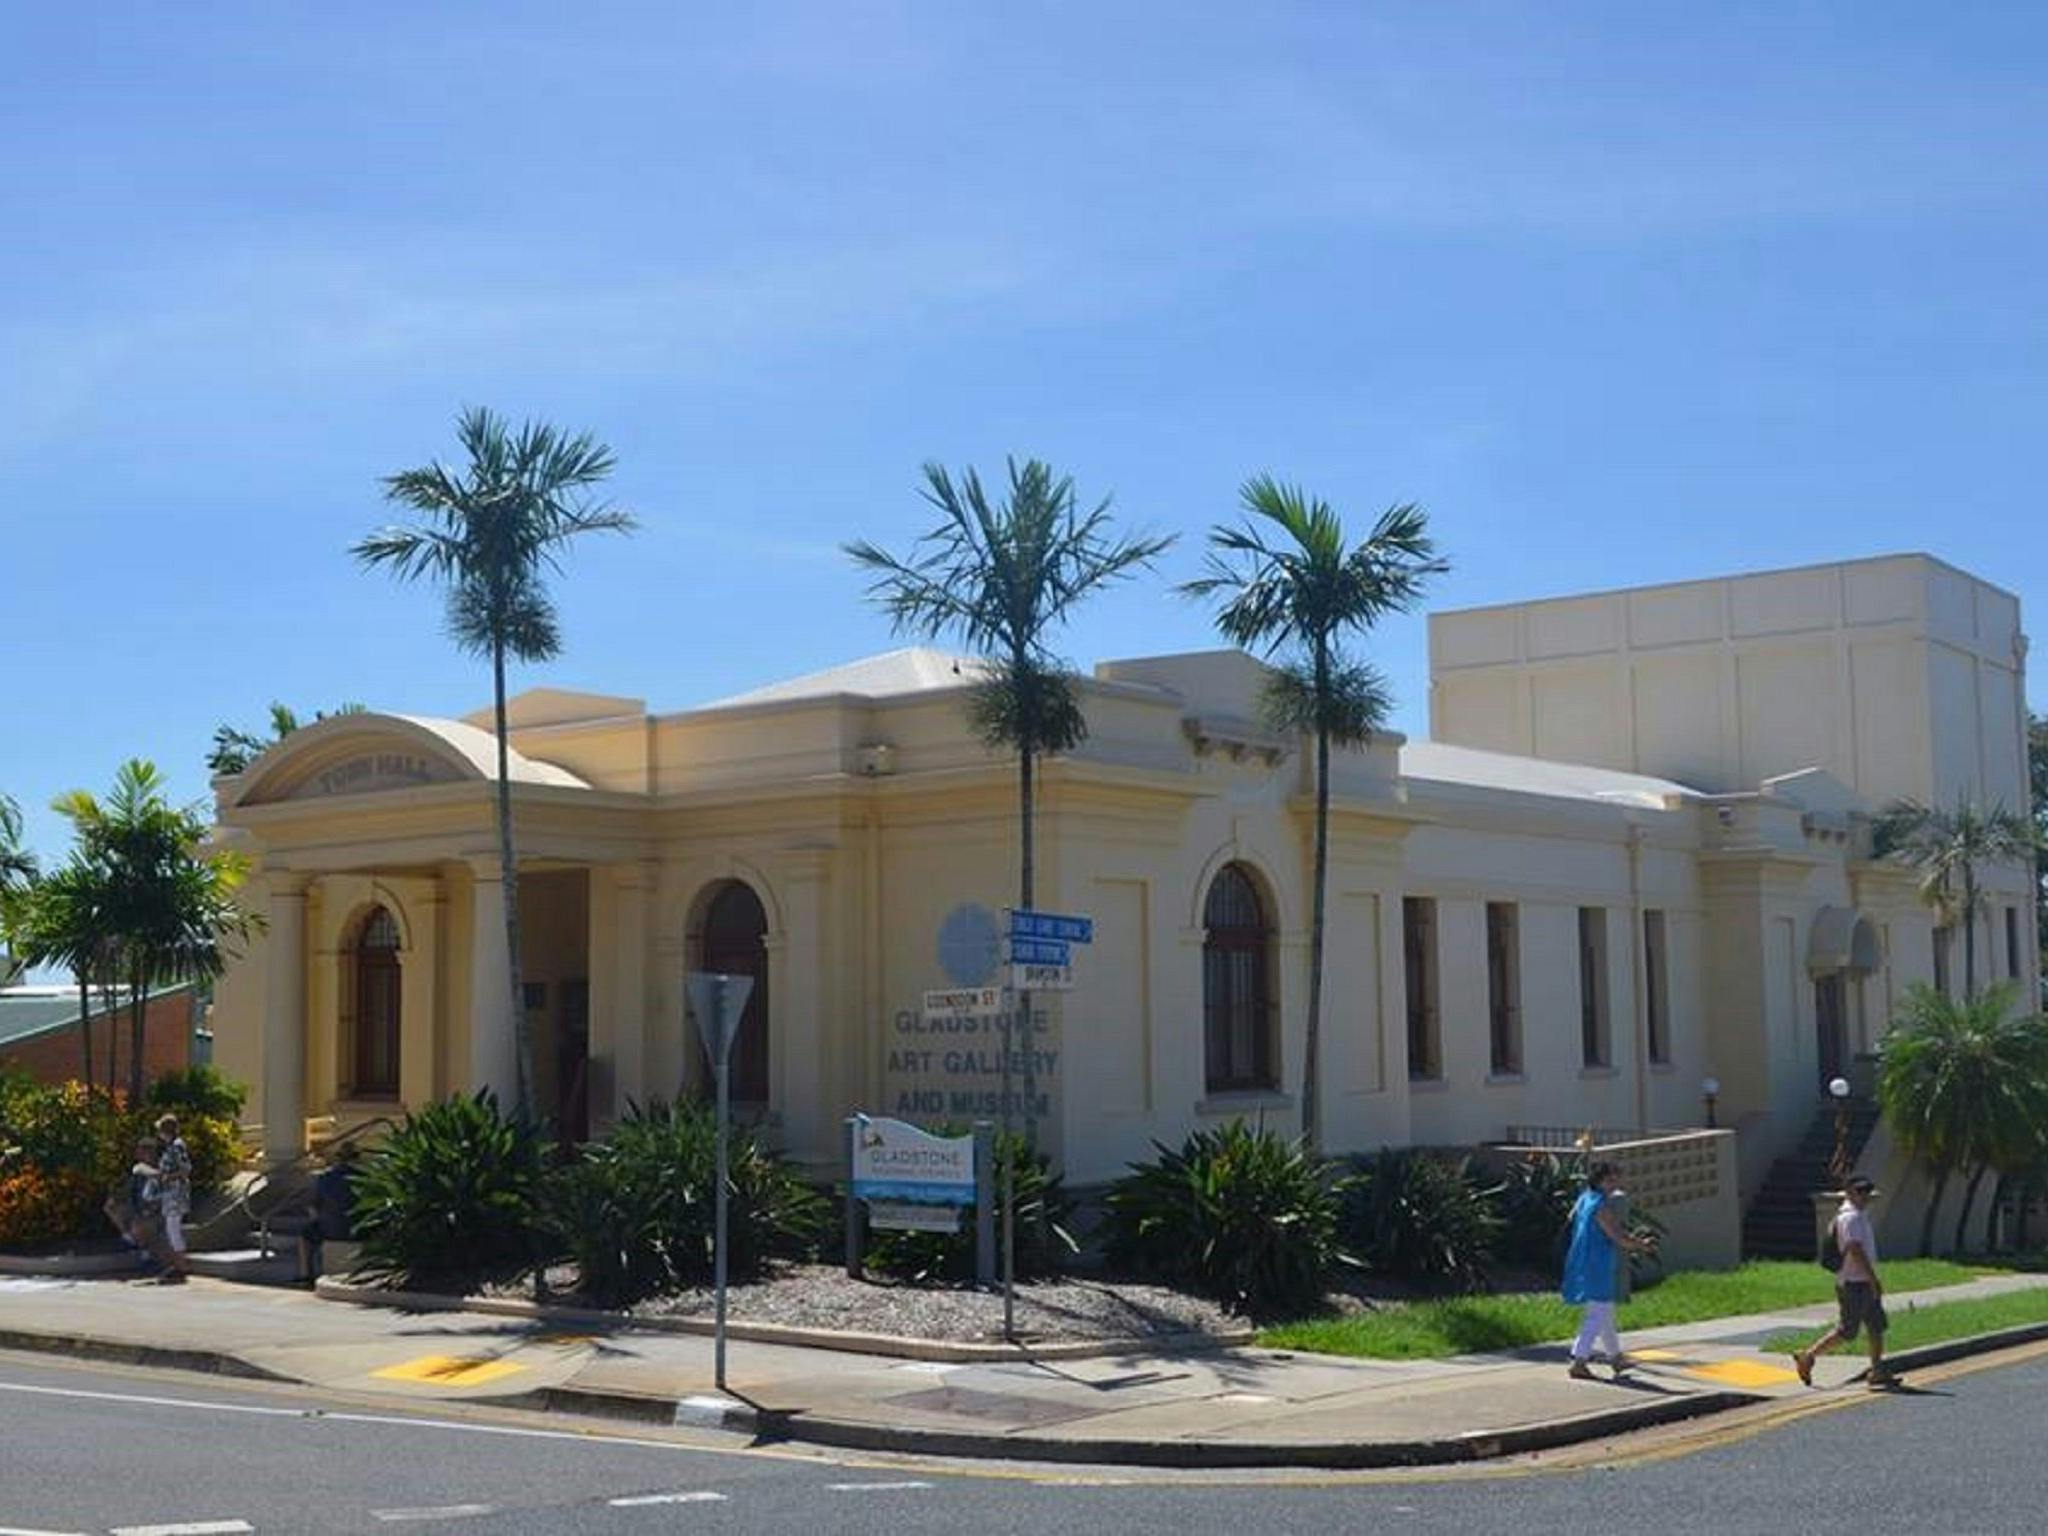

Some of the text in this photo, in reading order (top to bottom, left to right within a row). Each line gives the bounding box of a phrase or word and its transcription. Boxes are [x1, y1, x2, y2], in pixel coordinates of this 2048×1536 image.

[895, 1010, 1048, 1033] GLADSTONE
[889, 1051, 1058, 1074] ART GALLERY
[897, 1090, 943, 1113] AND
[871, 1149, 961, 1166] GLADSTONE
